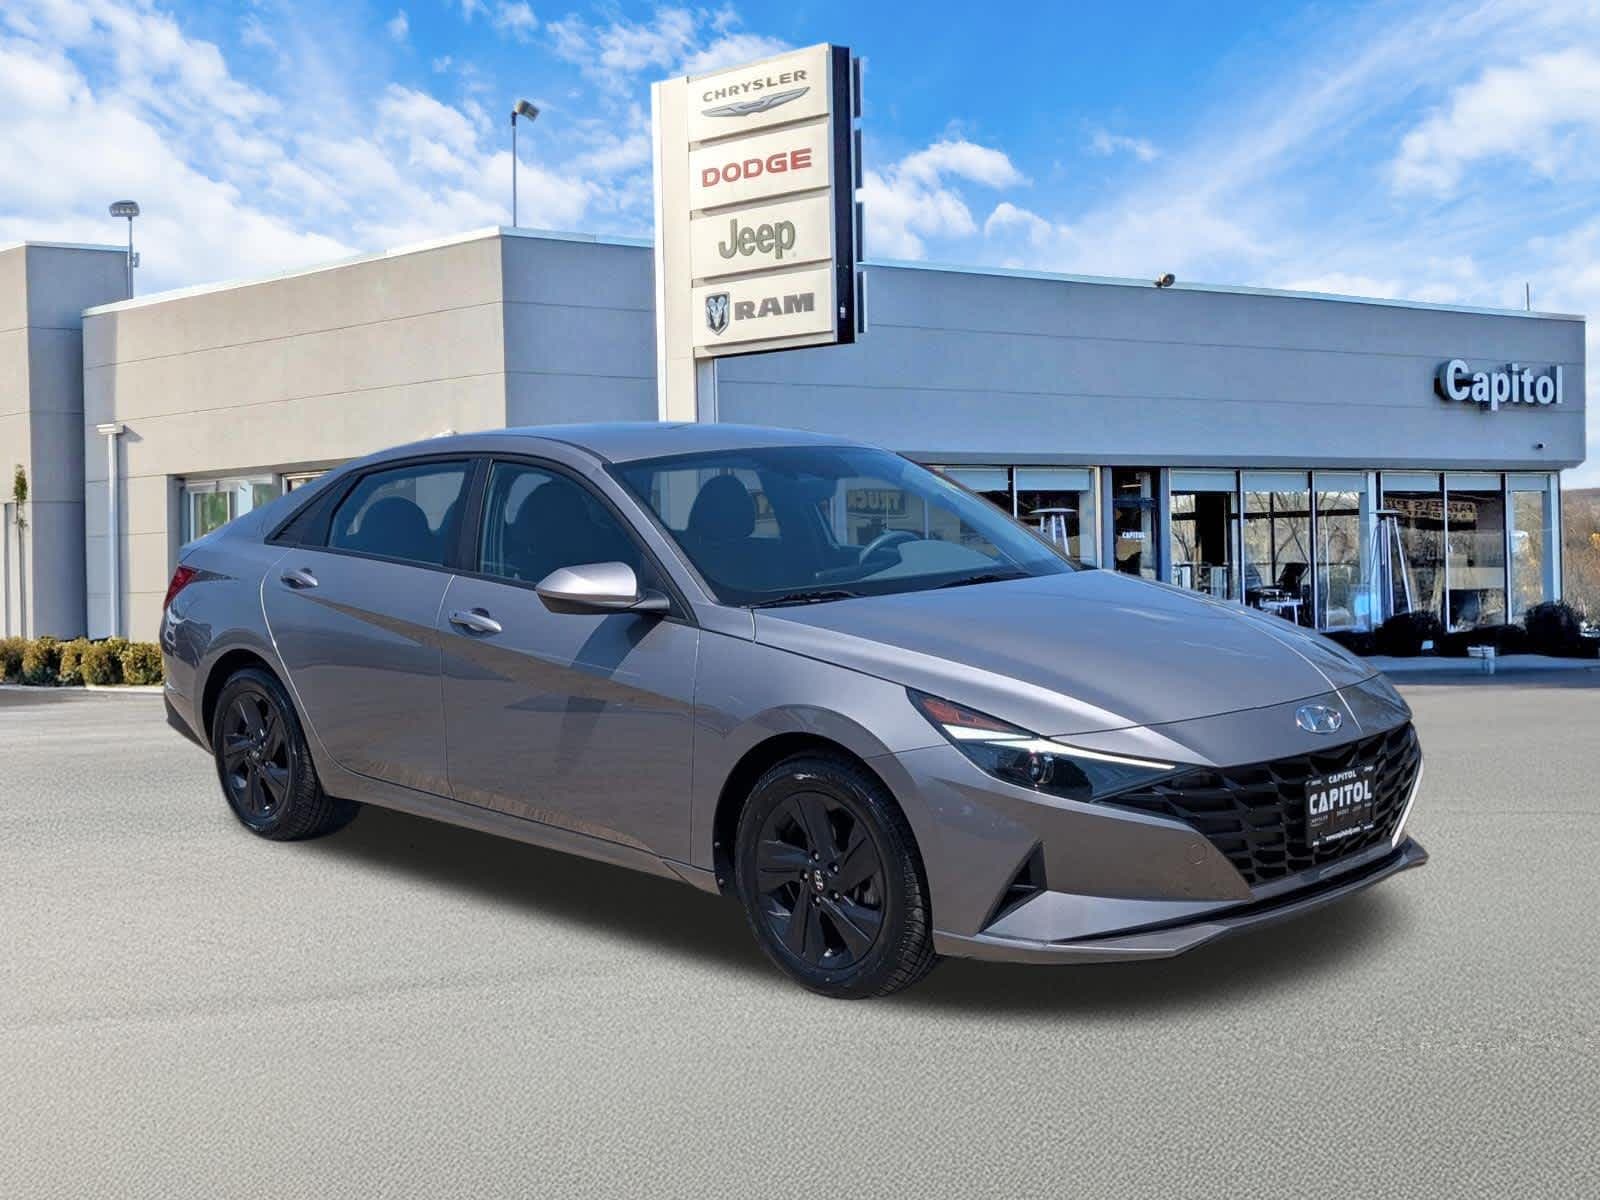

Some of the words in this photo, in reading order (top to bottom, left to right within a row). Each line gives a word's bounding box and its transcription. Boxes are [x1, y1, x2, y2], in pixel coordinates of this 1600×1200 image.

[702, 69, 808, 103] CHRYSLER
[701, 148, 813, 188] DODGE
[718, 218, 796, 260] Jeep
[733, 292, 815, 321] RAM
[1446, 359, 1563, 411] Capitol
[1328, 770, 1357, 784] CAPITOL
[1309, 780, 1372, 814] CAPITOL
